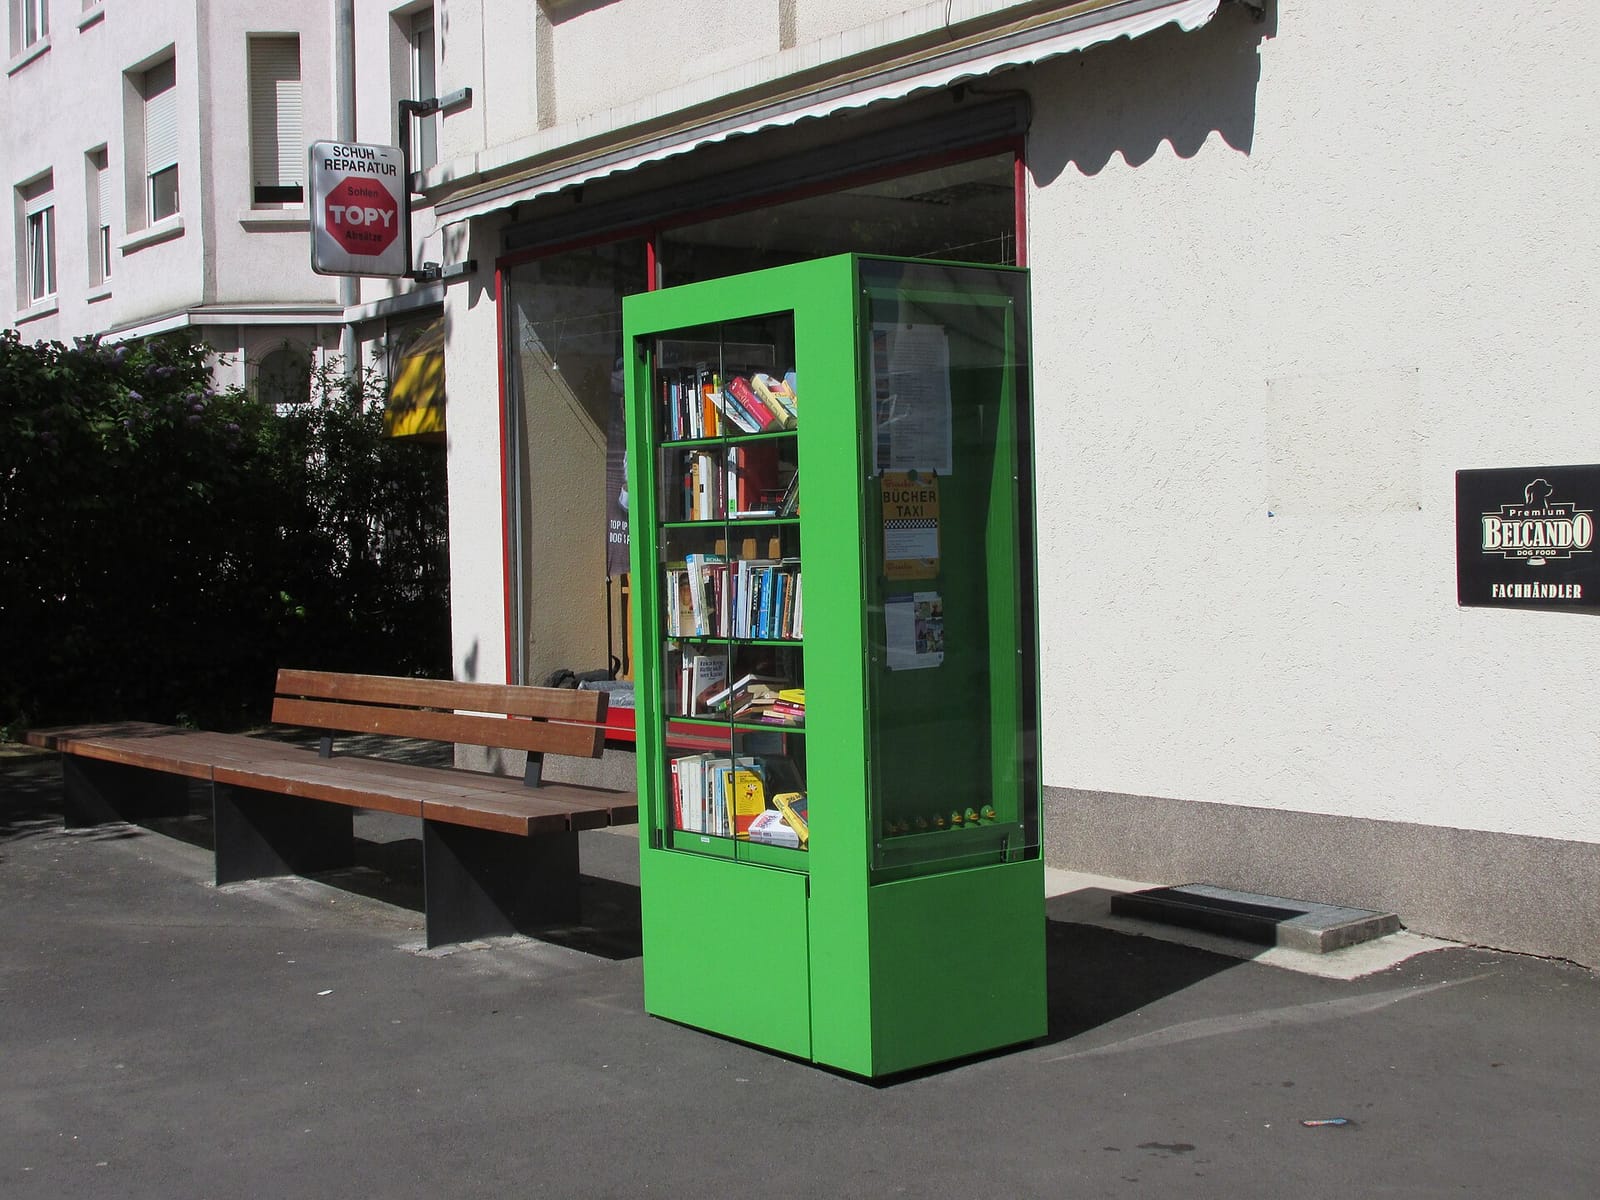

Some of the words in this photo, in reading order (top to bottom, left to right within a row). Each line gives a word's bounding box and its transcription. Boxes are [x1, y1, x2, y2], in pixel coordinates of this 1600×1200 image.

[333, 145, 375, 160] SCHUH
[324, 158, 397, 177] REPARATUR
[347, 186, 379, 198] Sohlen
[329, 204, 394, 228] TOPY
[345, 229, 383, 242] Absätze
[883, 488, 936, 503] BÜCHER
[896, 505, 924, 517] TAXI
[1509, 508, 1565, 517] Premium
[610, 519, 621, 530] TOP
[1483, 513, 1592, 549] BELCANDO
[1491, 581, 1582, 598] FACHHÄNDLER
